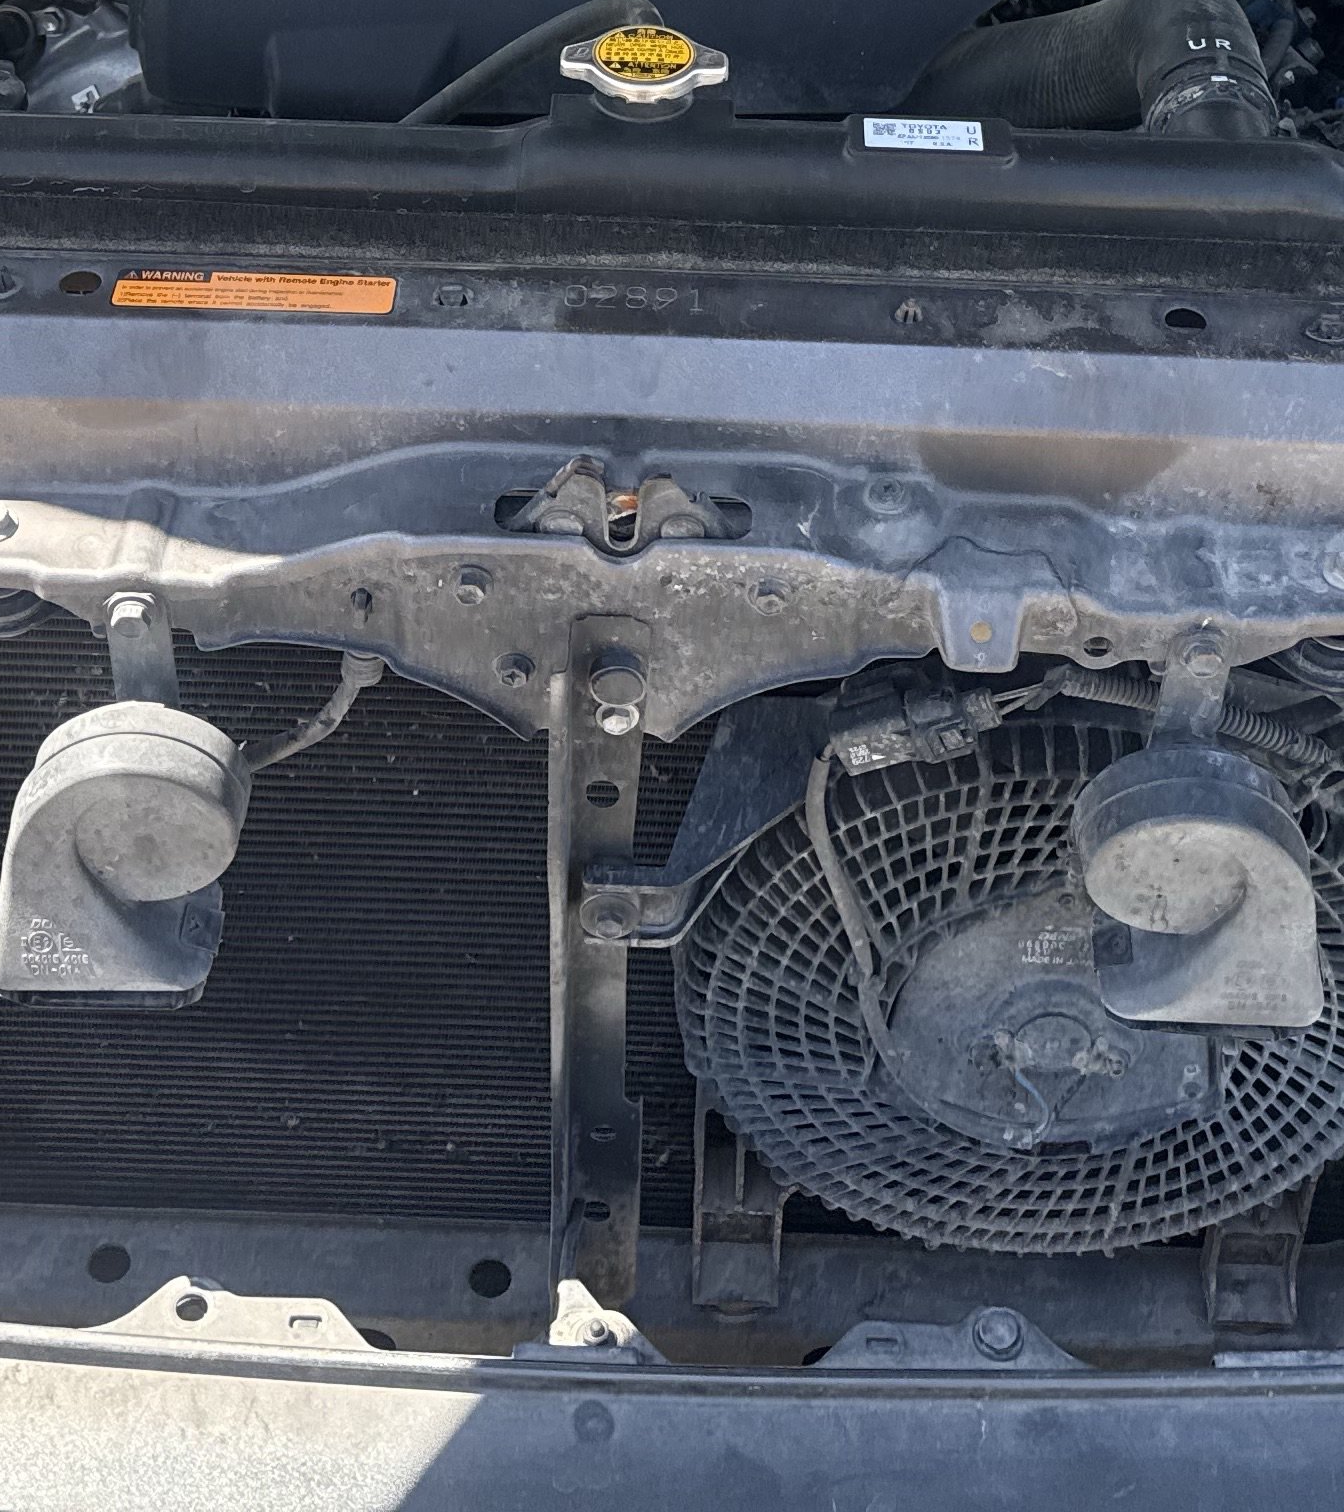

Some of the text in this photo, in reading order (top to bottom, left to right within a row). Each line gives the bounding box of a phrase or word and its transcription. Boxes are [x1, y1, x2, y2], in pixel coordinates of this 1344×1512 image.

[966, 126, 977, 135] U
[968, 137, 979, 147] R
[141, 270, 392, 287] WARNING Vehicle with Remote Engine Starter
